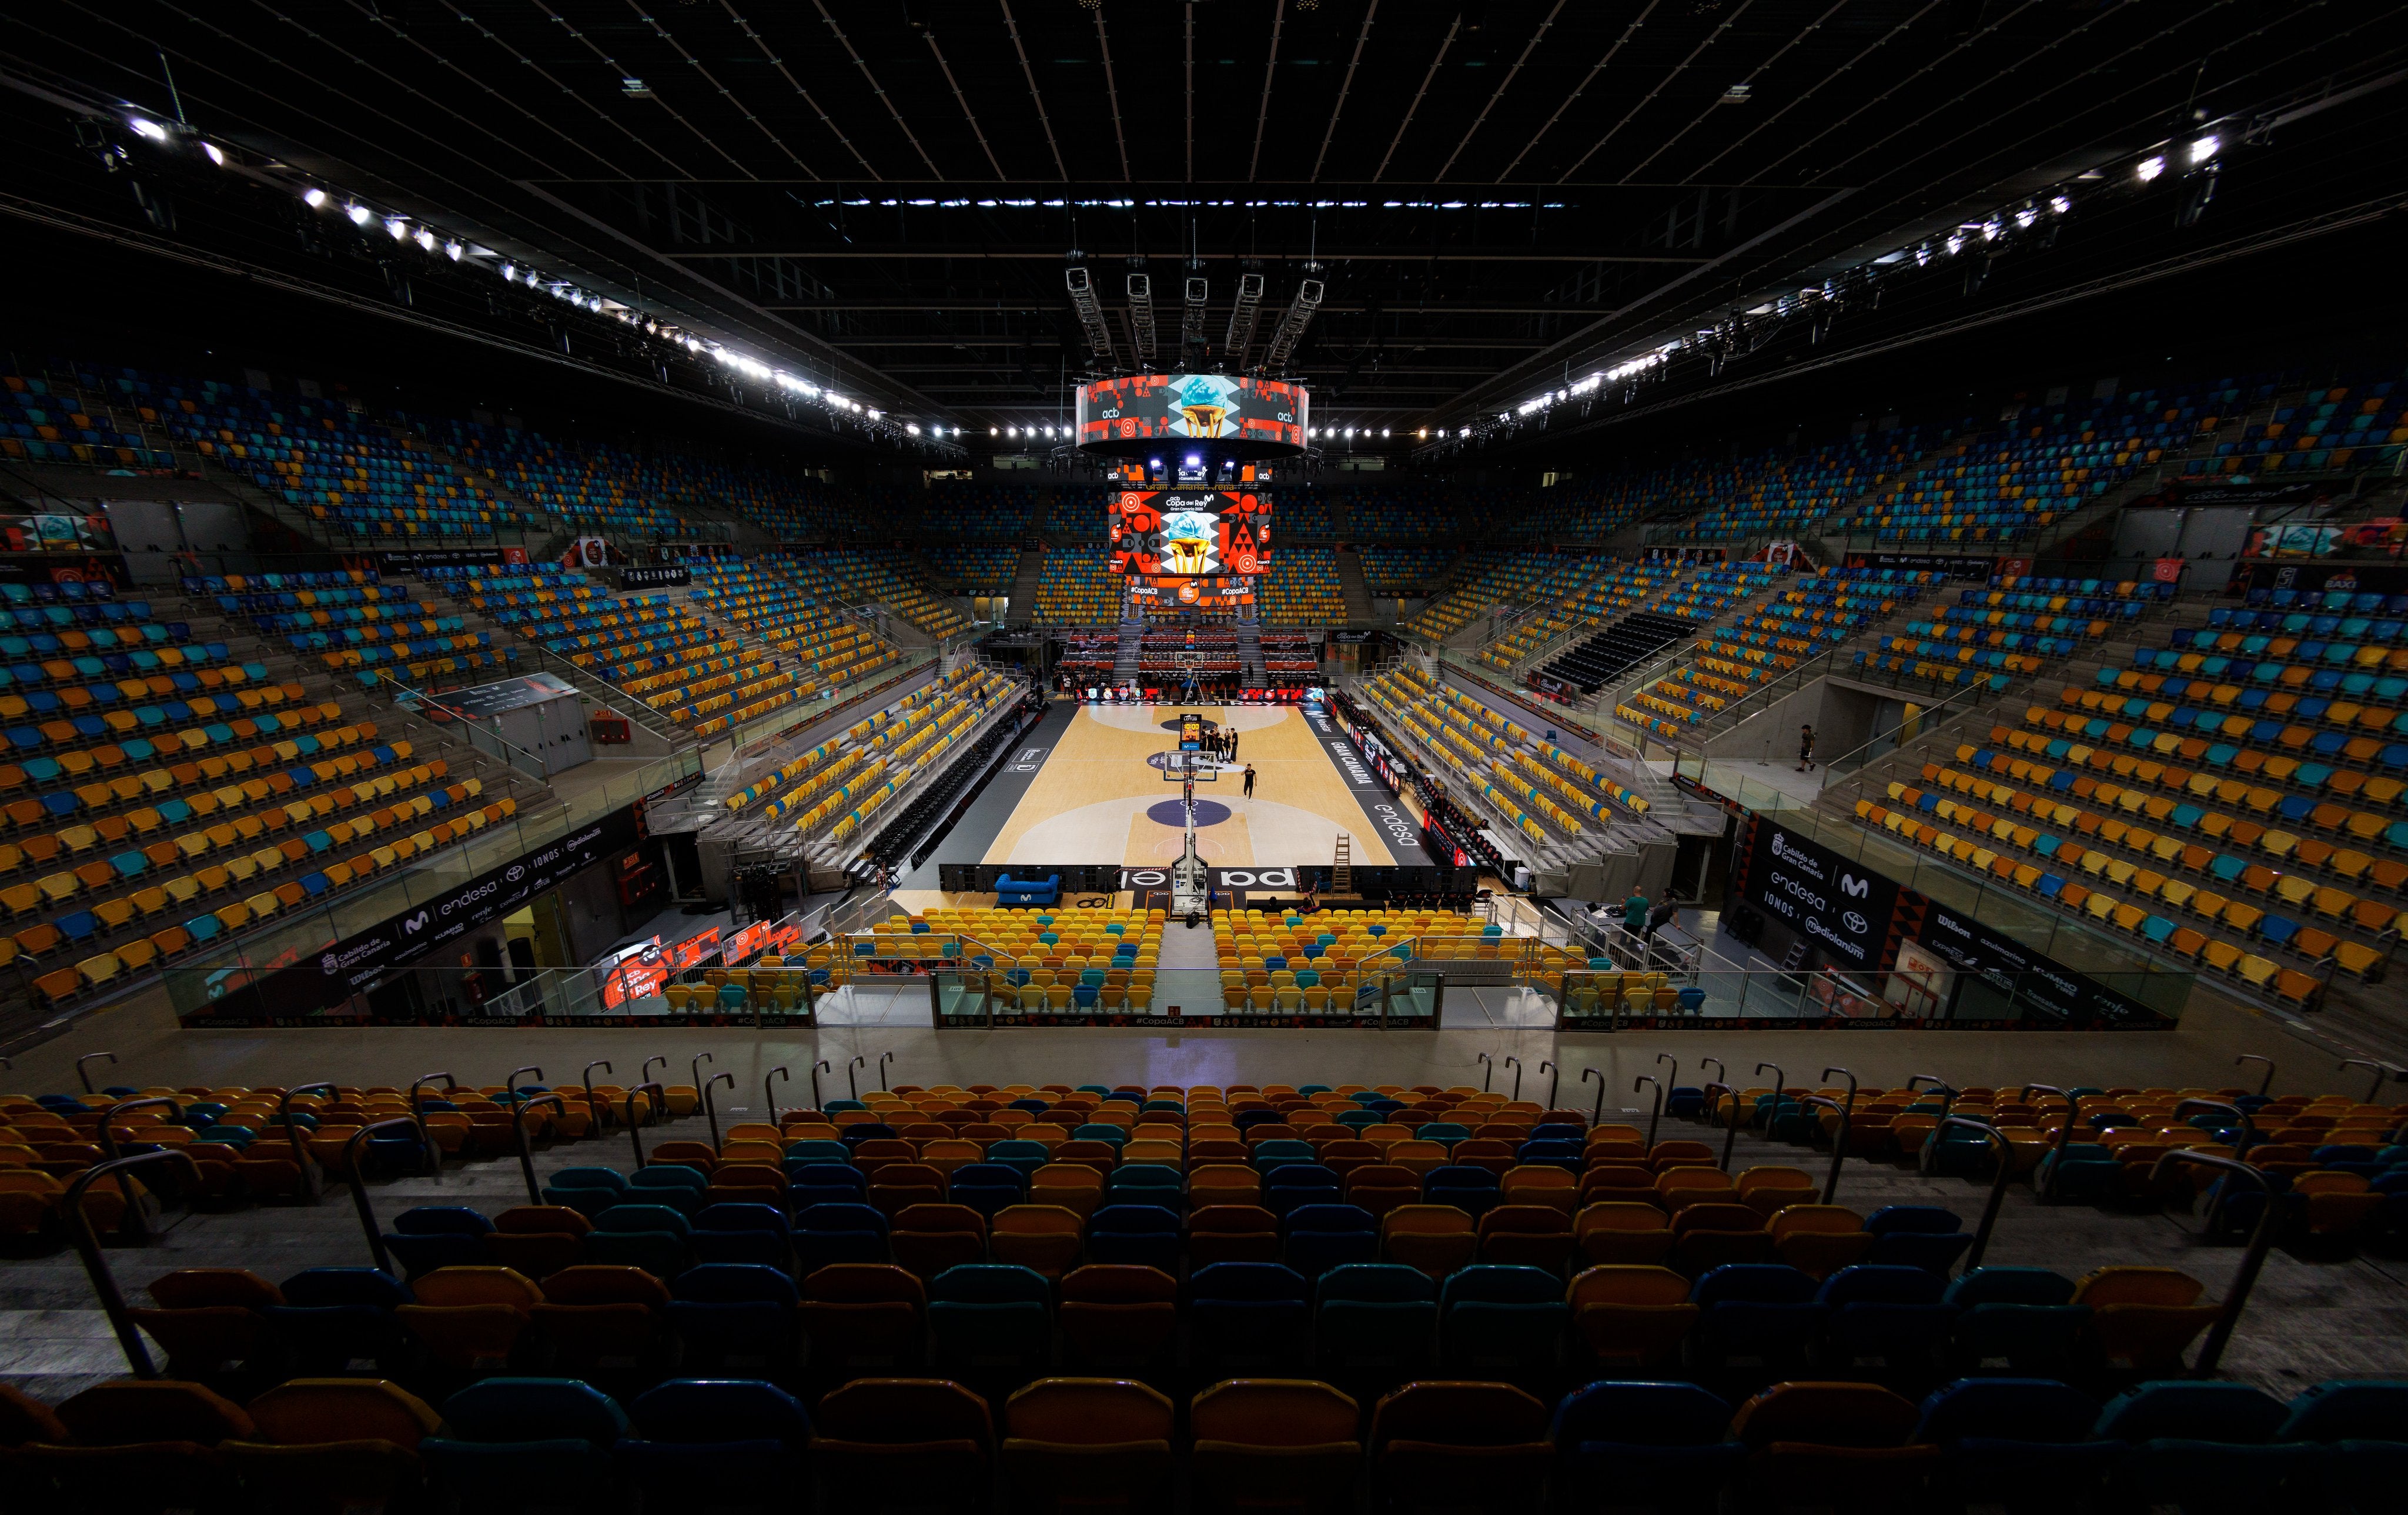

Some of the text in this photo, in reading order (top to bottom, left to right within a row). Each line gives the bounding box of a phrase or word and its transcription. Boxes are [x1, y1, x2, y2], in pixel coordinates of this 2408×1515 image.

[1102, 407, 1119, 419] acb
[1277, 411, 1292, 423] acb
[1166, 499, 1185, 508] Copa
[1131, 587, 1158, 595] #CopaACB
[1222, 587, 1249, 596] #CopaACB
[1540, 680, 1549, 688] Copa
[1330, 742, 1353, 756] GRAN
[1341, 757, 1373, 784] CANARIA
[1374, 804, 1420, 846] endesa
[568, 830, 601, 850] mediolanum
[533, 848, 559, 868] IONOS
[1783, 844, 1818, 868] Cabildo de
[1781, 852, 1824, 880] Gran Canaria
[534, 879, 551, 890] LOTUS
[1220, 868, 1297, 887] pa
[441, 881, 497, 915] endesa
[500, 894, 522, 908] EXPRESS
[1771, 872, 1826, 912] endesa
[471, 905, 493, 920] renfe
[1764, 891, 1794, 917] IONOS
[434, 922, 464, 940] KUMHO
[450, 927, 465, 937] TIRE
[1937, 914, 1972, 939] Wilson
[1807, 919, 1864, 960] mediolanum
[1850, 942, 1865, 953] BANCO
[338, 938, 381, 962] Cabildo de
[340, 941, 391, 968] Gran Canaria
[1931, 939, 1964, 961] EXPRESS
[1979, 938, 2026, 965] azulmarino
[349, 964, 385, 985] Wilson
[634, 979, 656, 996] Rey
[2054, 982, 2076, 998] TIRE
[467, 1017, 517, 1025] #CopaACB
[1580, 1019, 1628, 1028] #CopaCB
[1848, 1019, 1897, 1028] #CopaACB
